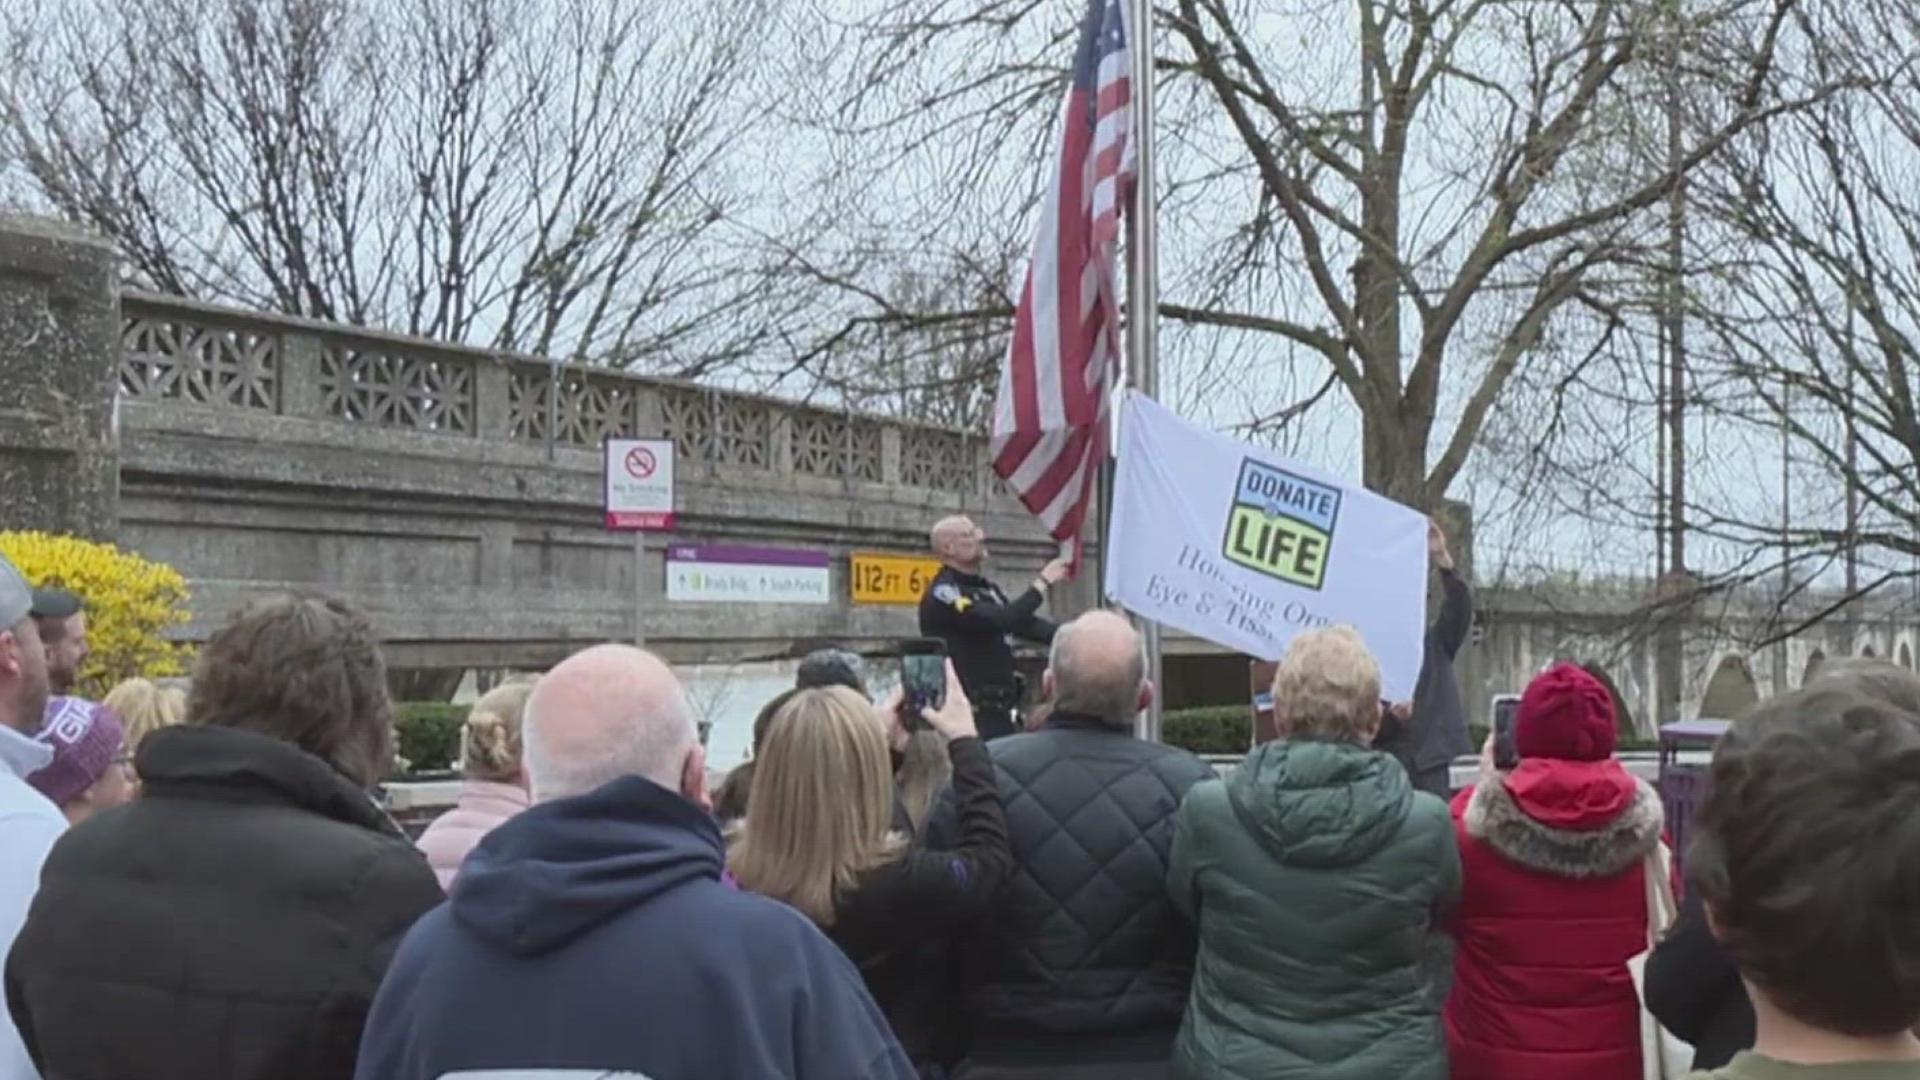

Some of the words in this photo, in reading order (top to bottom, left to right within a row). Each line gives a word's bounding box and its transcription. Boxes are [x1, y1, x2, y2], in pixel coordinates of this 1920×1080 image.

[1247, 469, 1332, 516] DONATE
[1234, 514, 1321, 578] LIFE
[864, 565, 883, 593] 12
[885, 573, 900, 595] FT
[909, 567, 921, 594] 6
[1146, 573, 1188, 608] Eye
[1195, 592, 1217, 616] &
